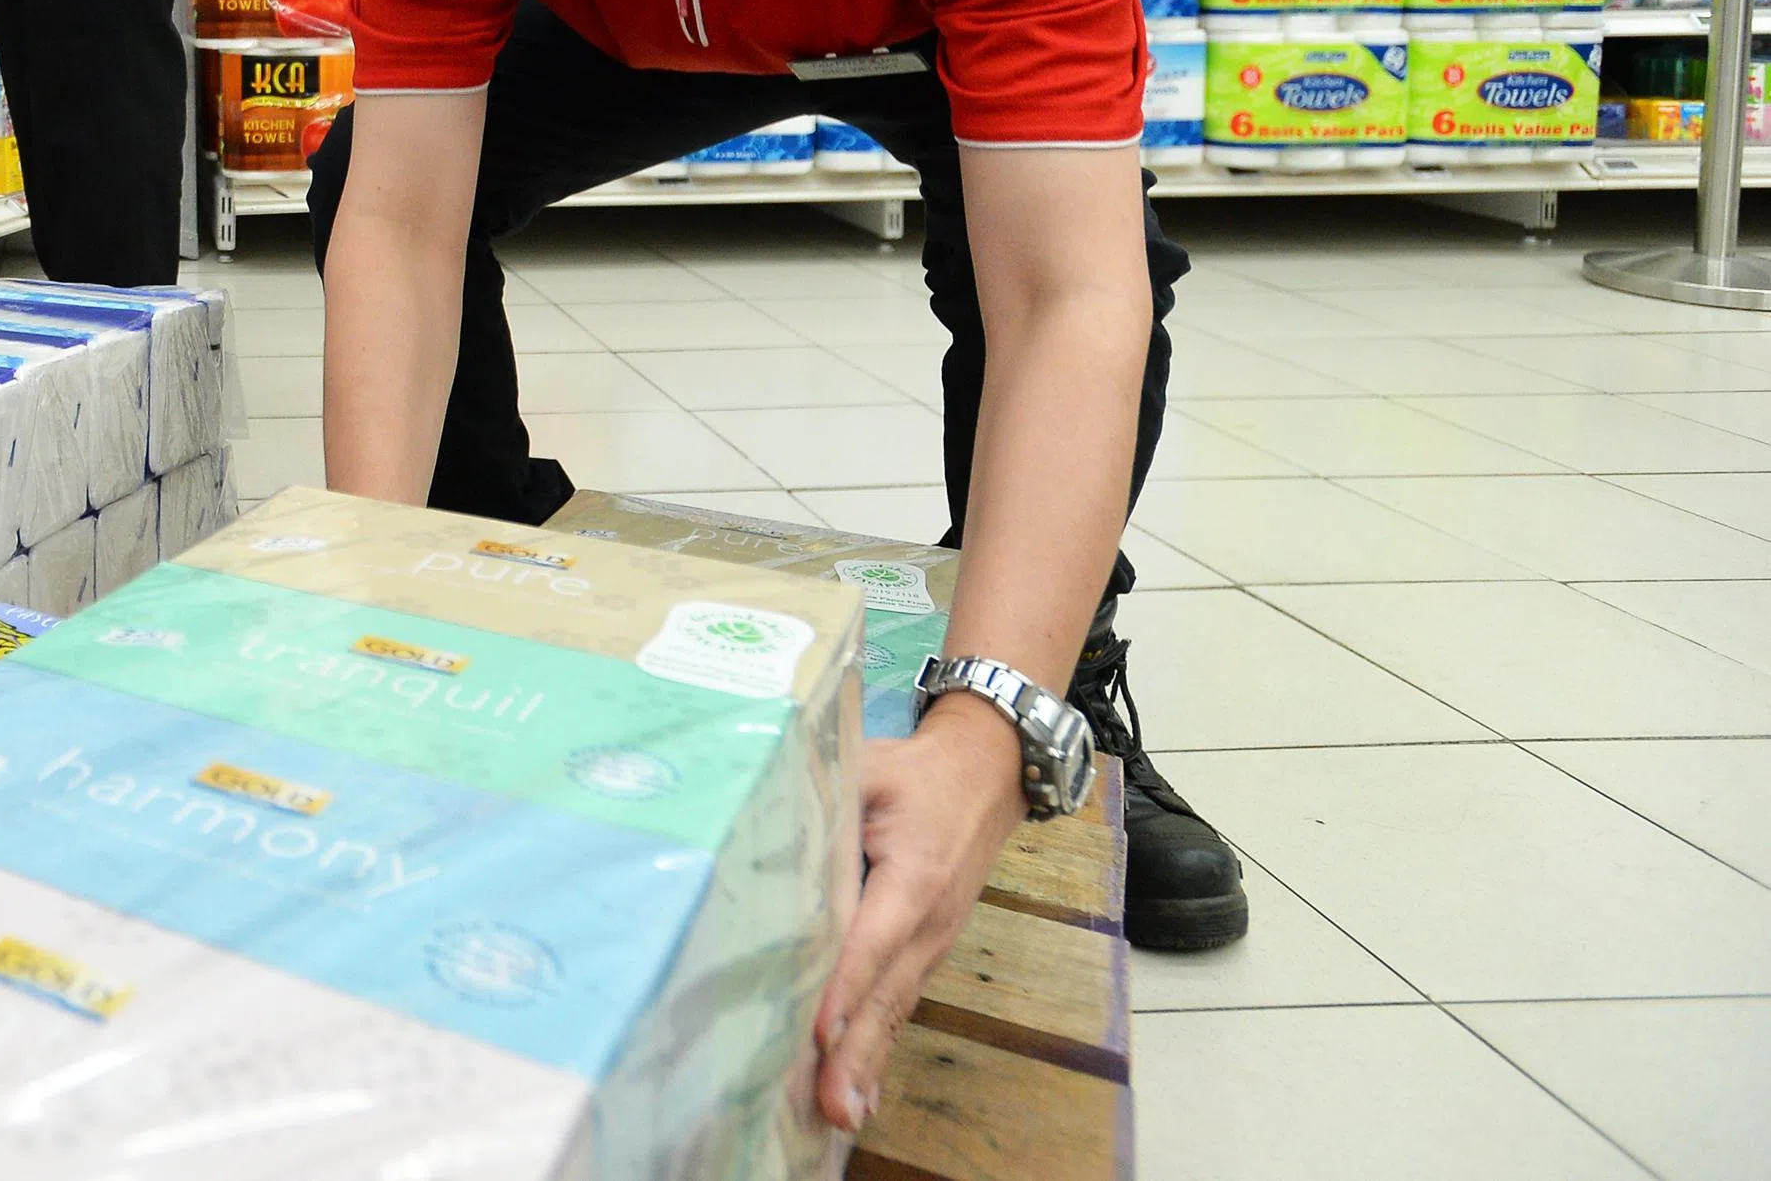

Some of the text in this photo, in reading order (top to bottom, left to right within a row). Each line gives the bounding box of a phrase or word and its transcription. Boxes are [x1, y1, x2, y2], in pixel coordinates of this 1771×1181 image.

[219, 0, 270, 12] TOWEL
[251, 62, 306, 97] KCA
[1279, 85, 1365, 111] Towels
[1484, 83, 1569, 108] Towels
[243, 119, 295, 132] KITCHEN
[1230, 111, 1254, 138] 6
[1311, 125, 1358, 137] Value
[1364, 124, 1404, 137] Pack
[1432, 110, 1595, 136] 6 Rolls Value Pa
[244, 132, 295, 144] TOWEL
[484, 543, 569, 568] GOLD
[414, 547, 592, 600] pure
[364, 643, 461, 671] GOLD
[237, 631, 547, 726] tranquil
[212, 770, 322, 811] GOLD
[36, 747, 437, 902] harmony
